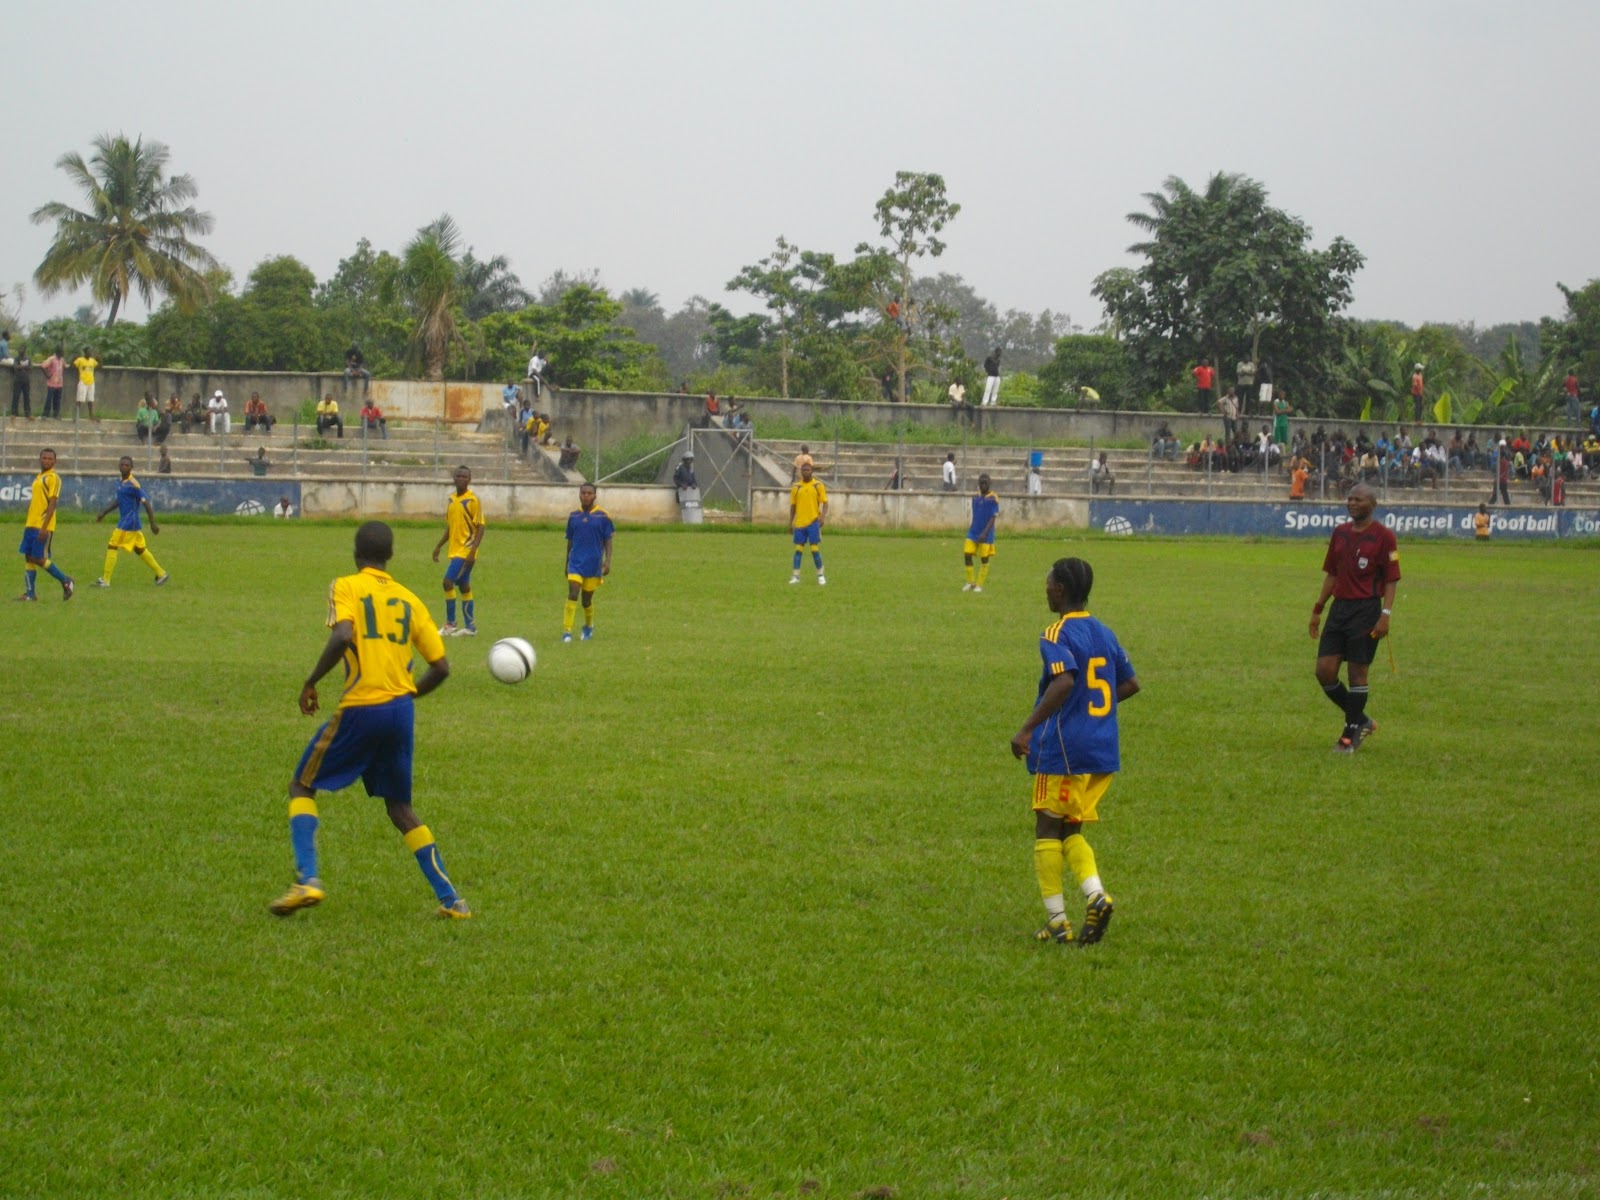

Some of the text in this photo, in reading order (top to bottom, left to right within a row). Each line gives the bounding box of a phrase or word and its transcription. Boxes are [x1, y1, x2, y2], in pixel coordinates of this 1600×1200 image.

[1385, 512, 1453, 532] Officiel
[360, 593, 412, 646] 13
[1087, 656, 1112, 717] 5
